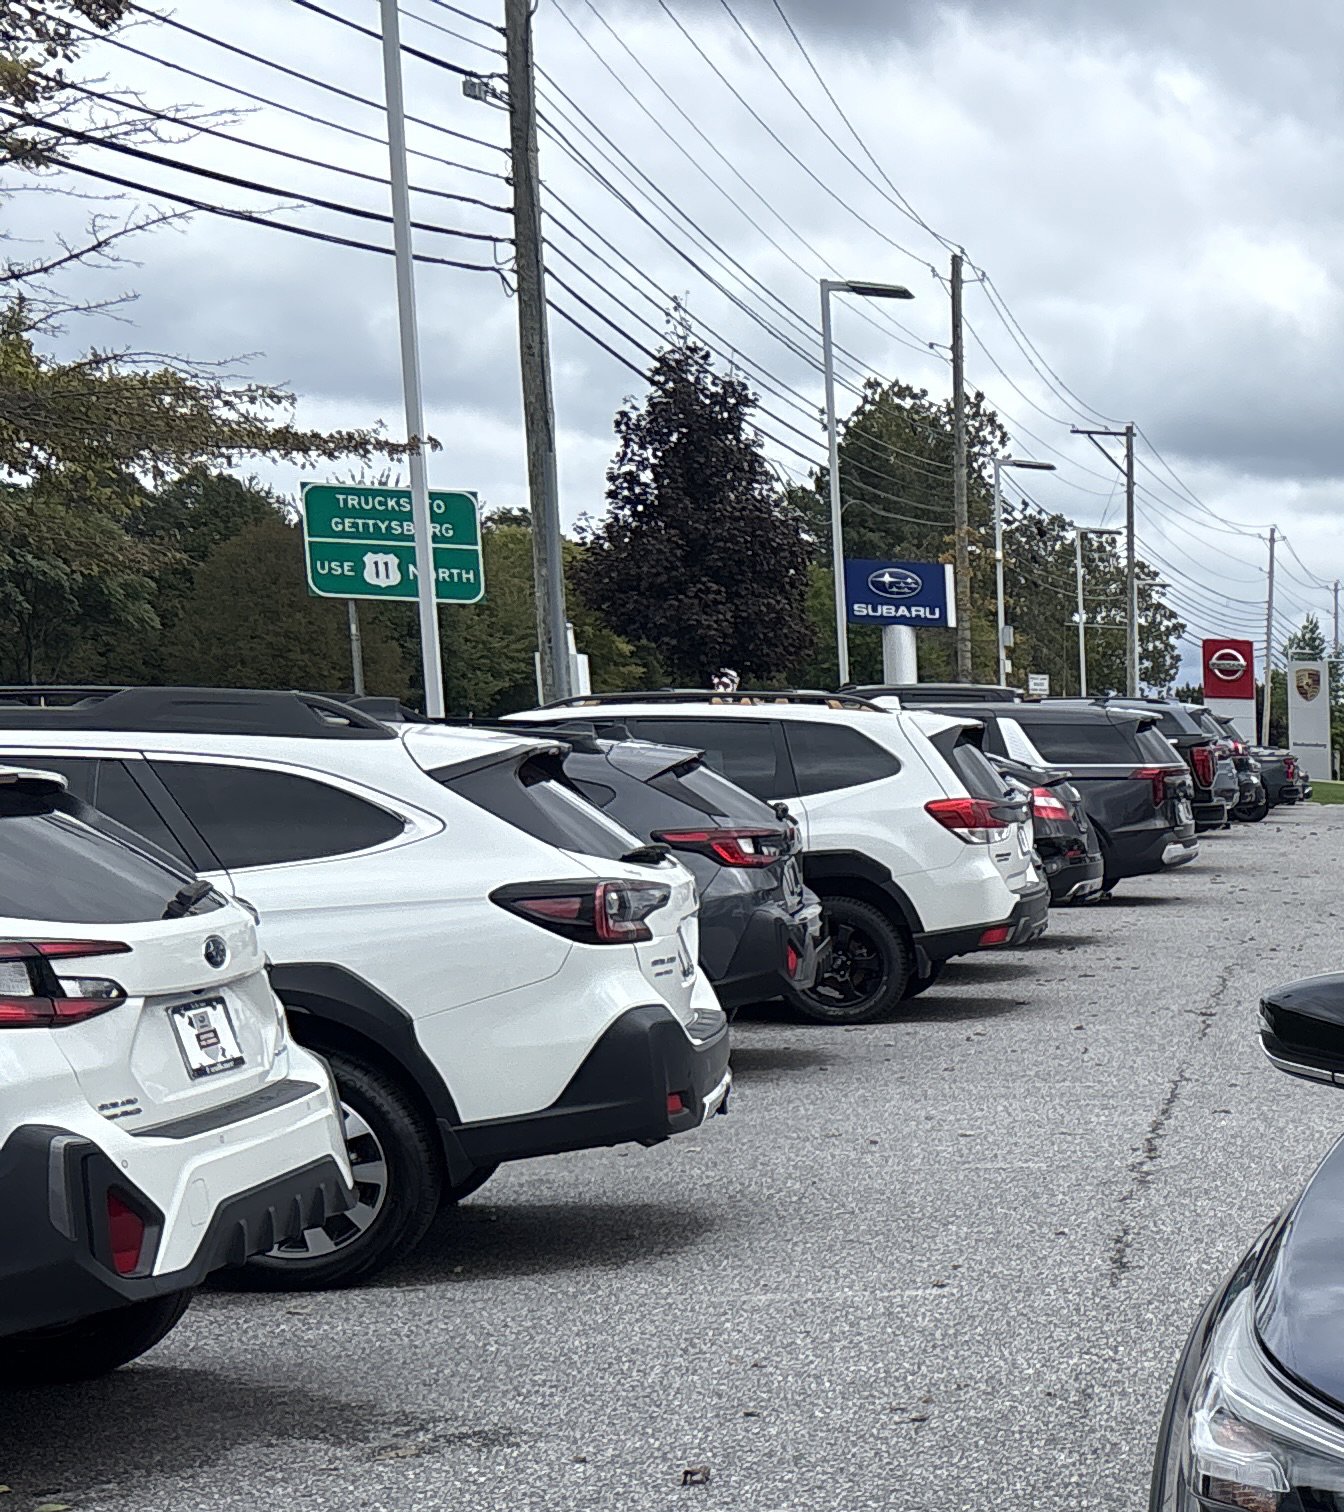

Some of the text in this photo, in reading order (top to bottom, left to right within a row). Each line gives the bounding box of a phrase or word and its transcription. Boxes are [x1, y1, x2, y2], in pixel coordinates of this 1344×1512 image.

[335, 493, 412, 512] TRUCKS
[331, 517, 454, 537] GETTYSBRG
[316, 560, 475, 584] USE 11 NRTH
[853, 603, 940, 619] SUBARU
